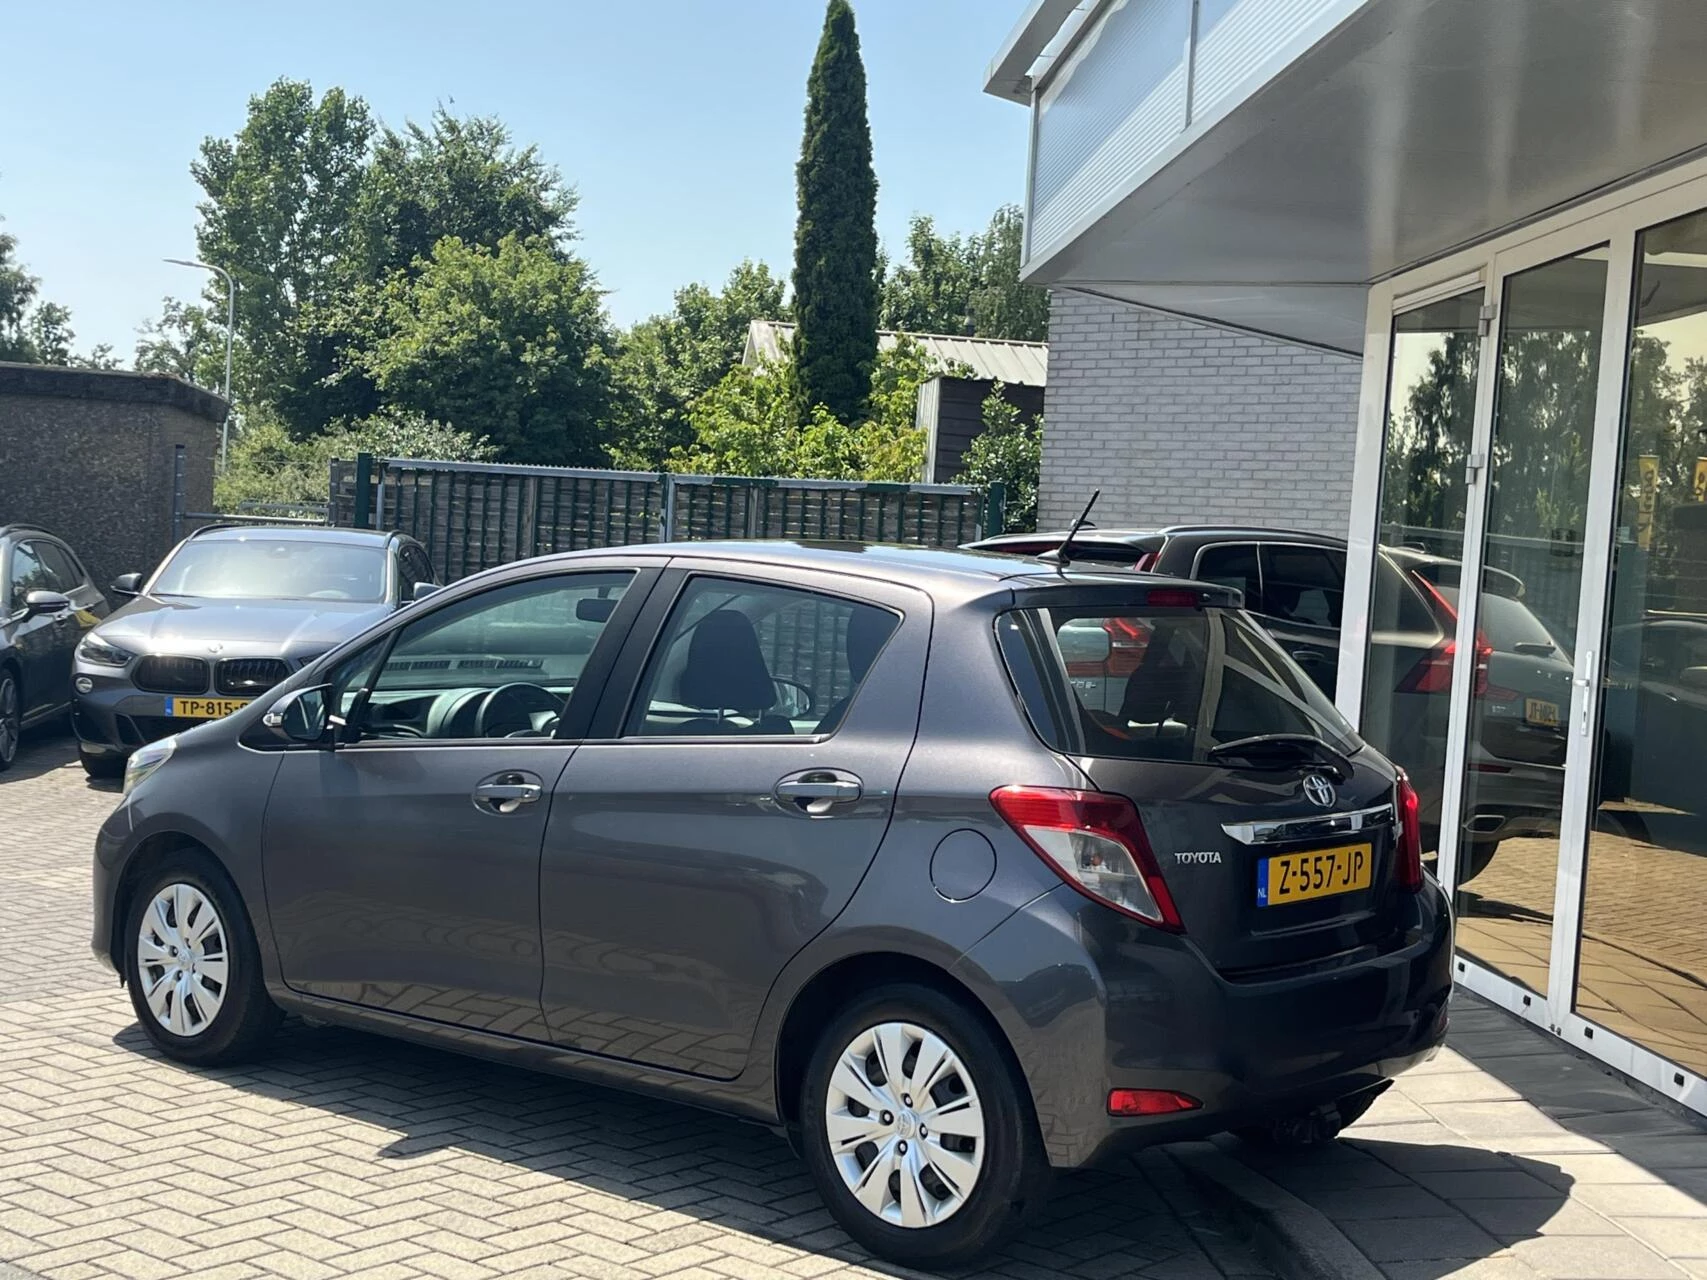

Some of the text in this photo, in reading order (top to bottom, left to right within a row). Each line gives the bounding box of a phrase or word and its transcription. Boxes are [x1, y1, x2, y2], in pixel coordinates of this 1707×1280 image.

[1174, 851, 1222, 865] TOYOTA
[1278, 851, 1364, 896] Z-557-JP
[1257, 887, 1267, 898] NL
